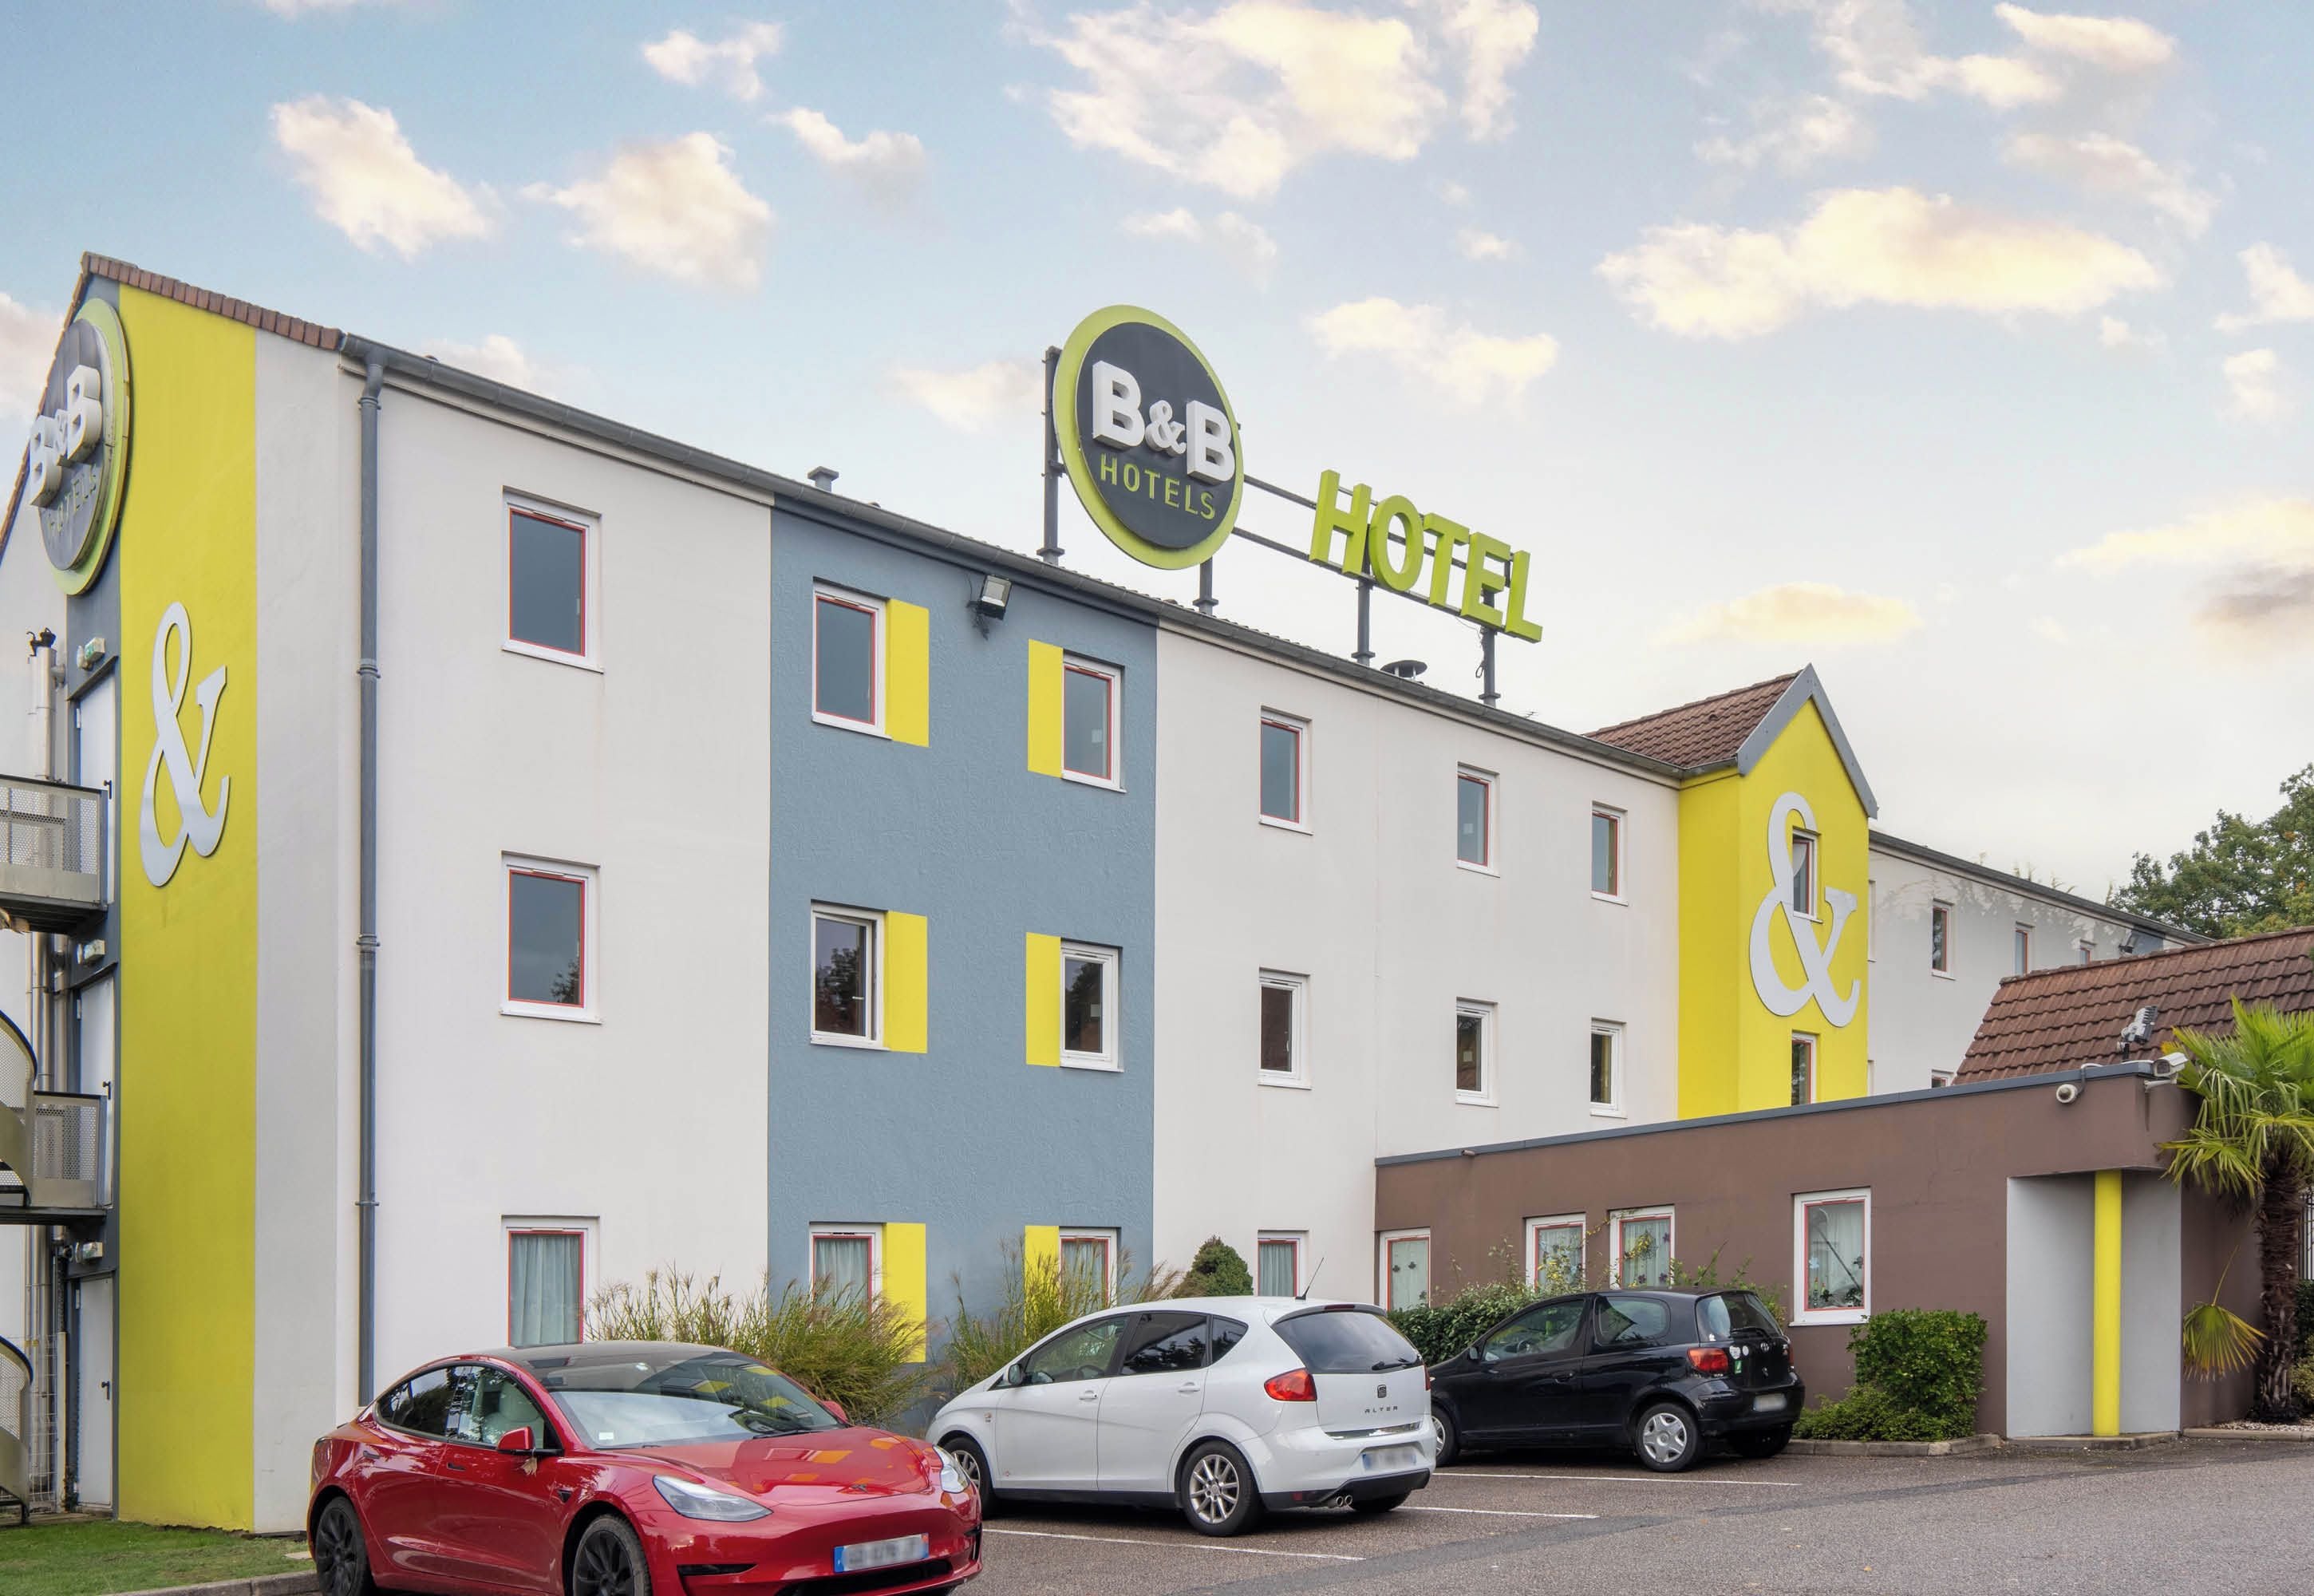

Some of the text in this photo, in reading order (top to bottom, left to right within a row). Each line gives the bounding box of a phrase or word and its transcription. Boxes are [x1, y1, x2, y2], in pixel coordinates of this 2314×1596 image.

[1092, 360, 1236, 485] B&B
[1100, 452, 1215, 520] HOTELS
[1309, 469, 1543, 644] HOTEL
[139, 601, 230, 888] &
[1749, 791, 1861, 1029] &
